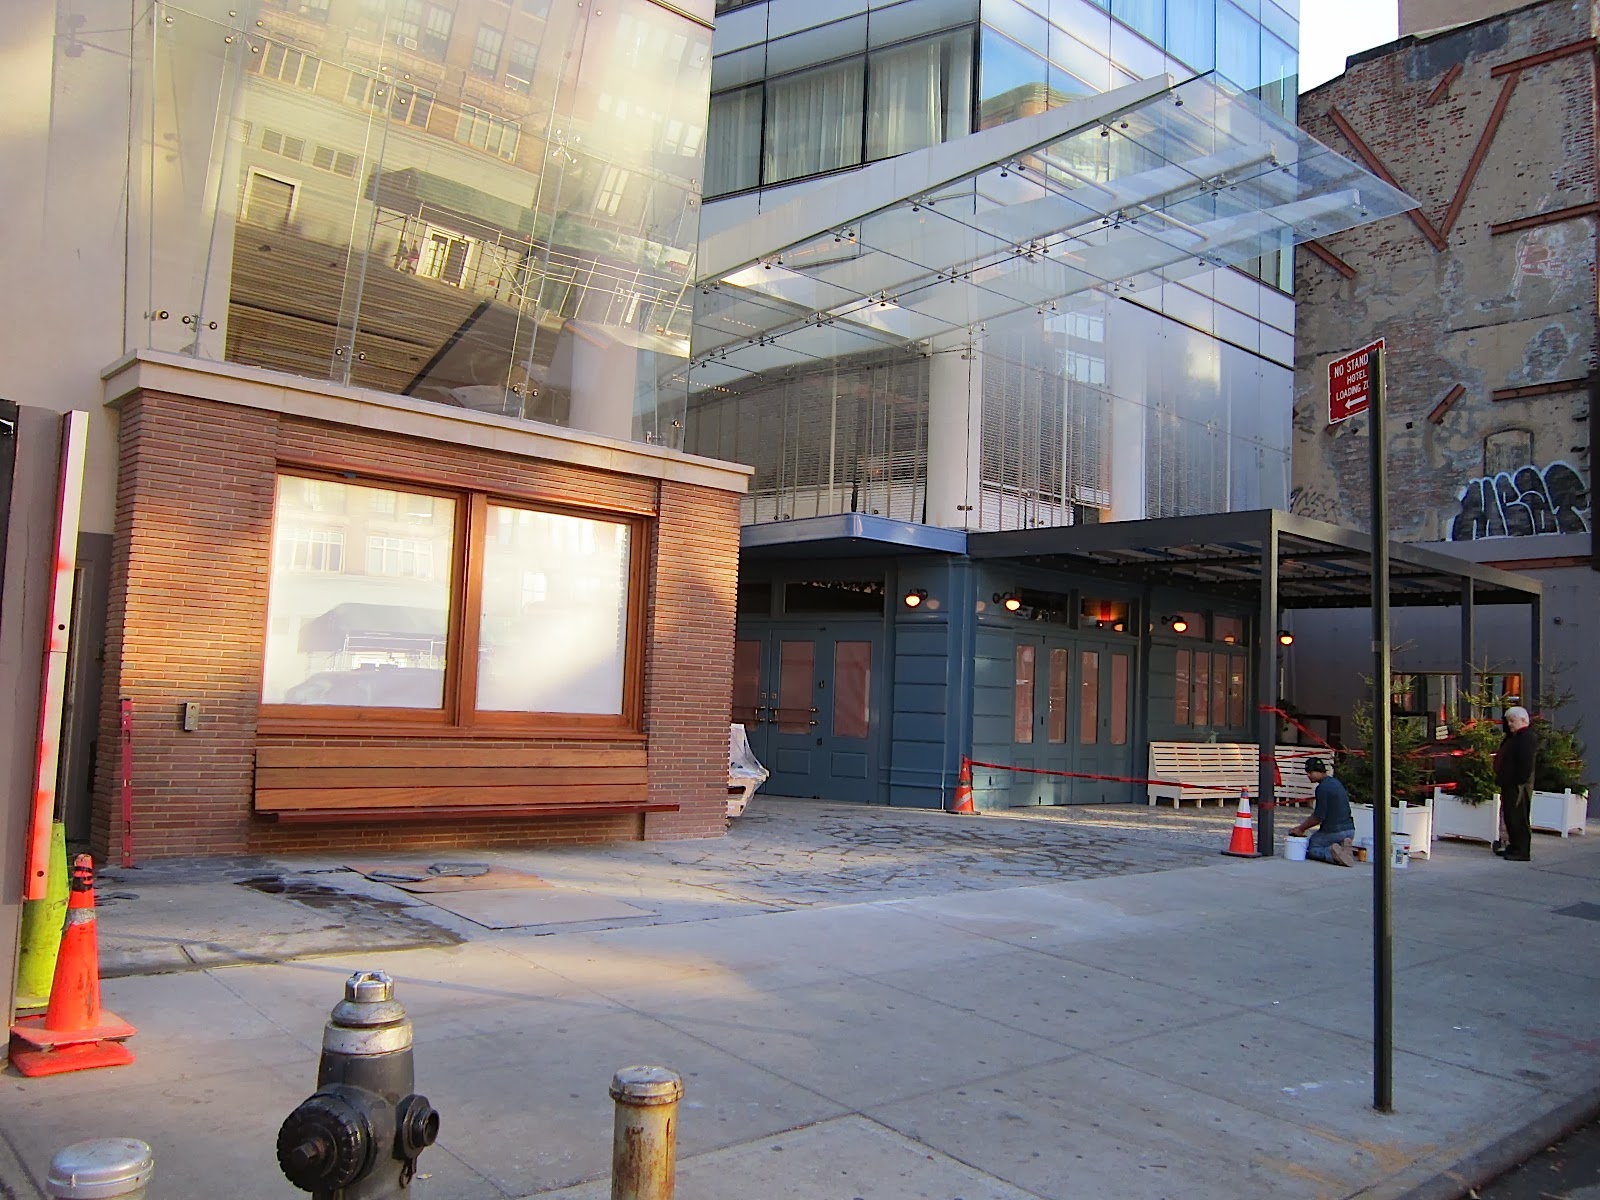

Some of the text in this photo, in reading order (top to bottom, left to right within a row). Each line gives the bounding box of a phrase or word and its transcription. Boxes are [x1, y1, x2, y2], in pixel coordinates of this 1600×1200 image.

[1334, 353, 1369, 378] NO STAND
[1346, 369, 1367, 385] HOTEL
[1335, 383, 1361, 401] LOADING
